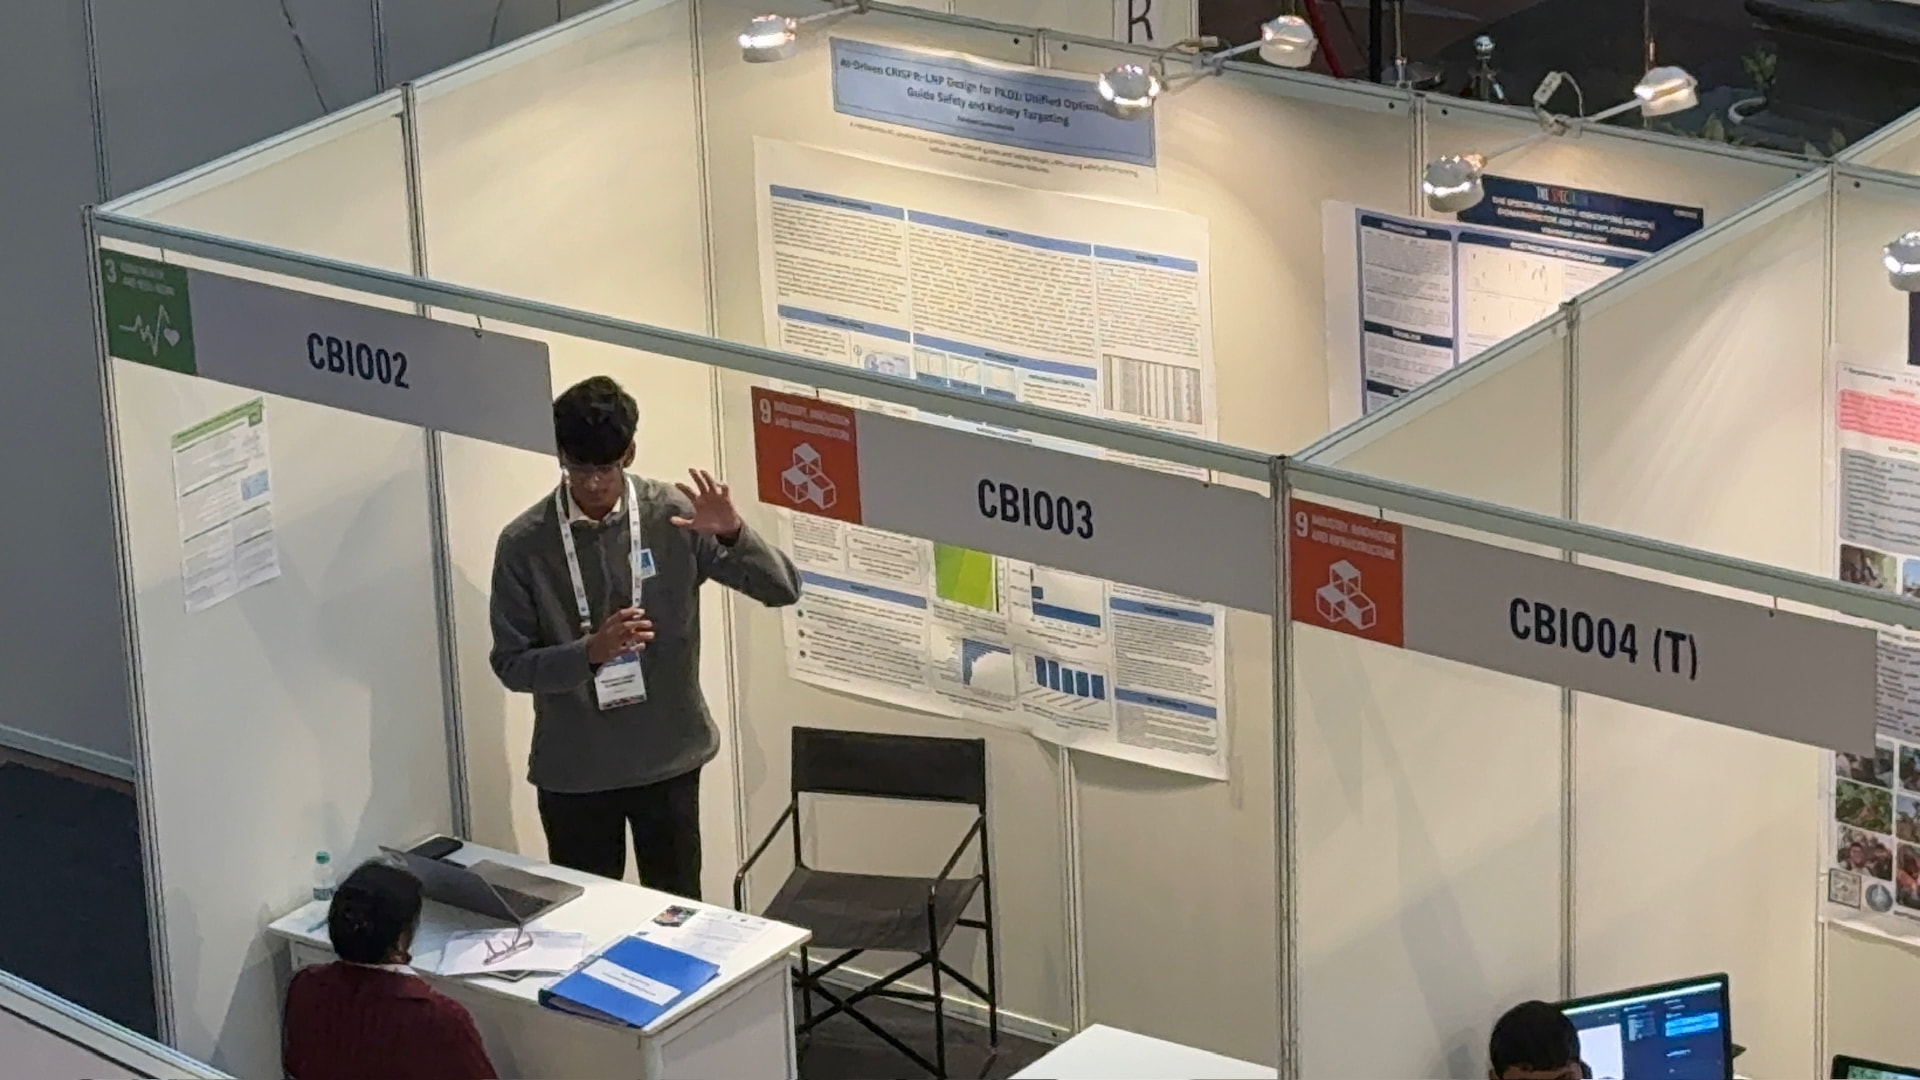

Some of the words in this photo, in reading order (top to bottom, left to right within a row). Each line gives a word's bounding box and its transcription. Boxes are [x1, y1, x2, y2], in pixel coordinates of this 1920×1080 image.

[1128, 0, 1153, 43] R
[907, 86, 934, 101] Guide
[938, 92, 966, 109] Safety
[105, 258, 117, 283] 3
[760, 398, 772, 424] 9
[1295, 511, 1309, 538] 9
[1653, 627, 1698, 681] (T)
